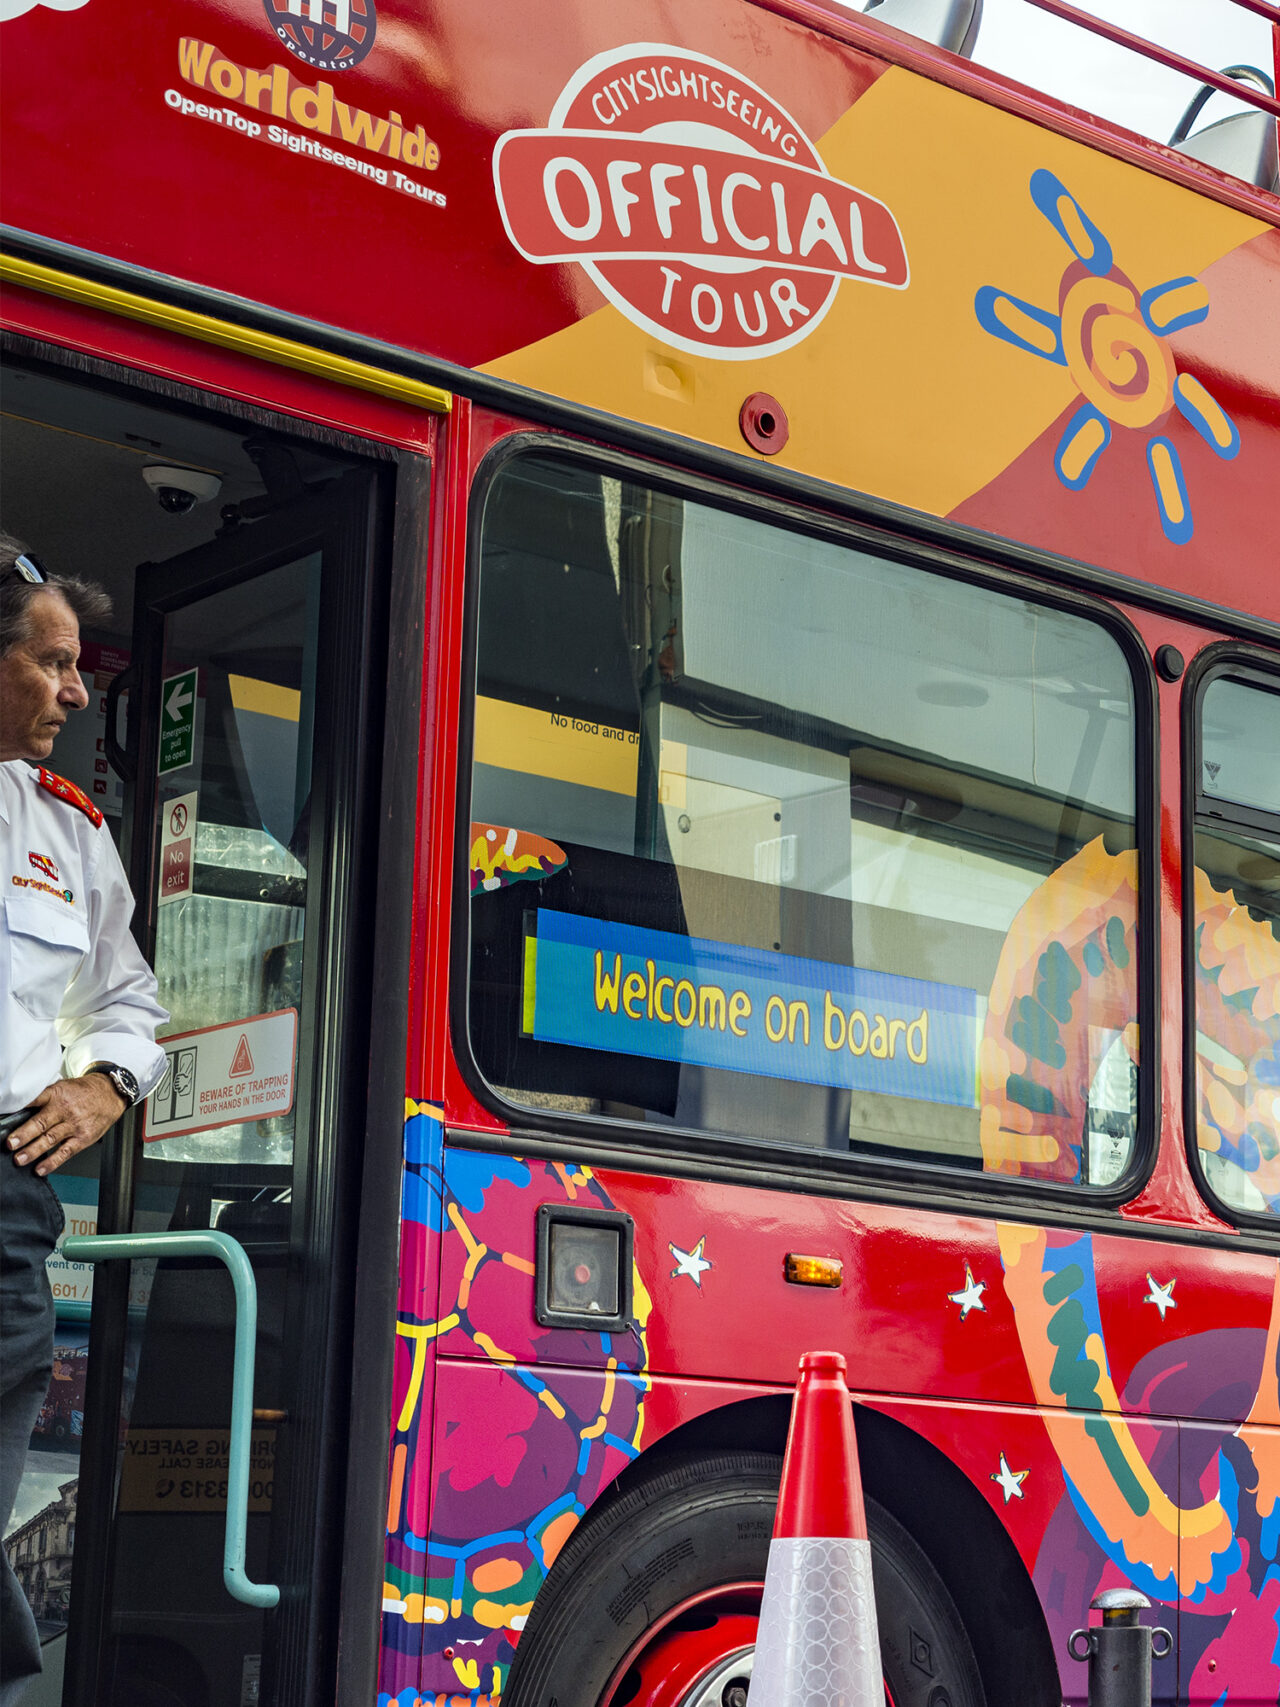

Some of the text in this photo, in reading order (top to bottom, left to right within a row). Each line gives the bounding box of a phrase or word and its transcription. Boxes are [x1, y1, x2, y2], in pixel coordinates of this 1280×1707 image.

[179, 37, 440, 171] Worldwide
[592, 65, 799, 158] CITYSIGHTSEEING
[164, 88, 447, 208] OpenTop Sightseeing Tours
[542, 156, 887, 273] OFFICIAL
[660, 266, 810, 338] TOUR
[163, 724, 191, 740] Emergency
[551, 713, 568, 728] No
[572, 718, 599, 735] food
[602, 726, 625, 741] and
[165, 750, 186, 762] to open
[171, 738, 181, 750] pull
[169, 851, 184, 866] No
[167, 871, 184, 888] exit
[594, 949, 928, 1065] Welcome on board
[199, 1089, 287, 1115] YOUR HANDS IN THE DOOR
[200, 1073, 289, 1103] BEWARE OF TRAPPING
[72, 1263, 85, 1271] on
